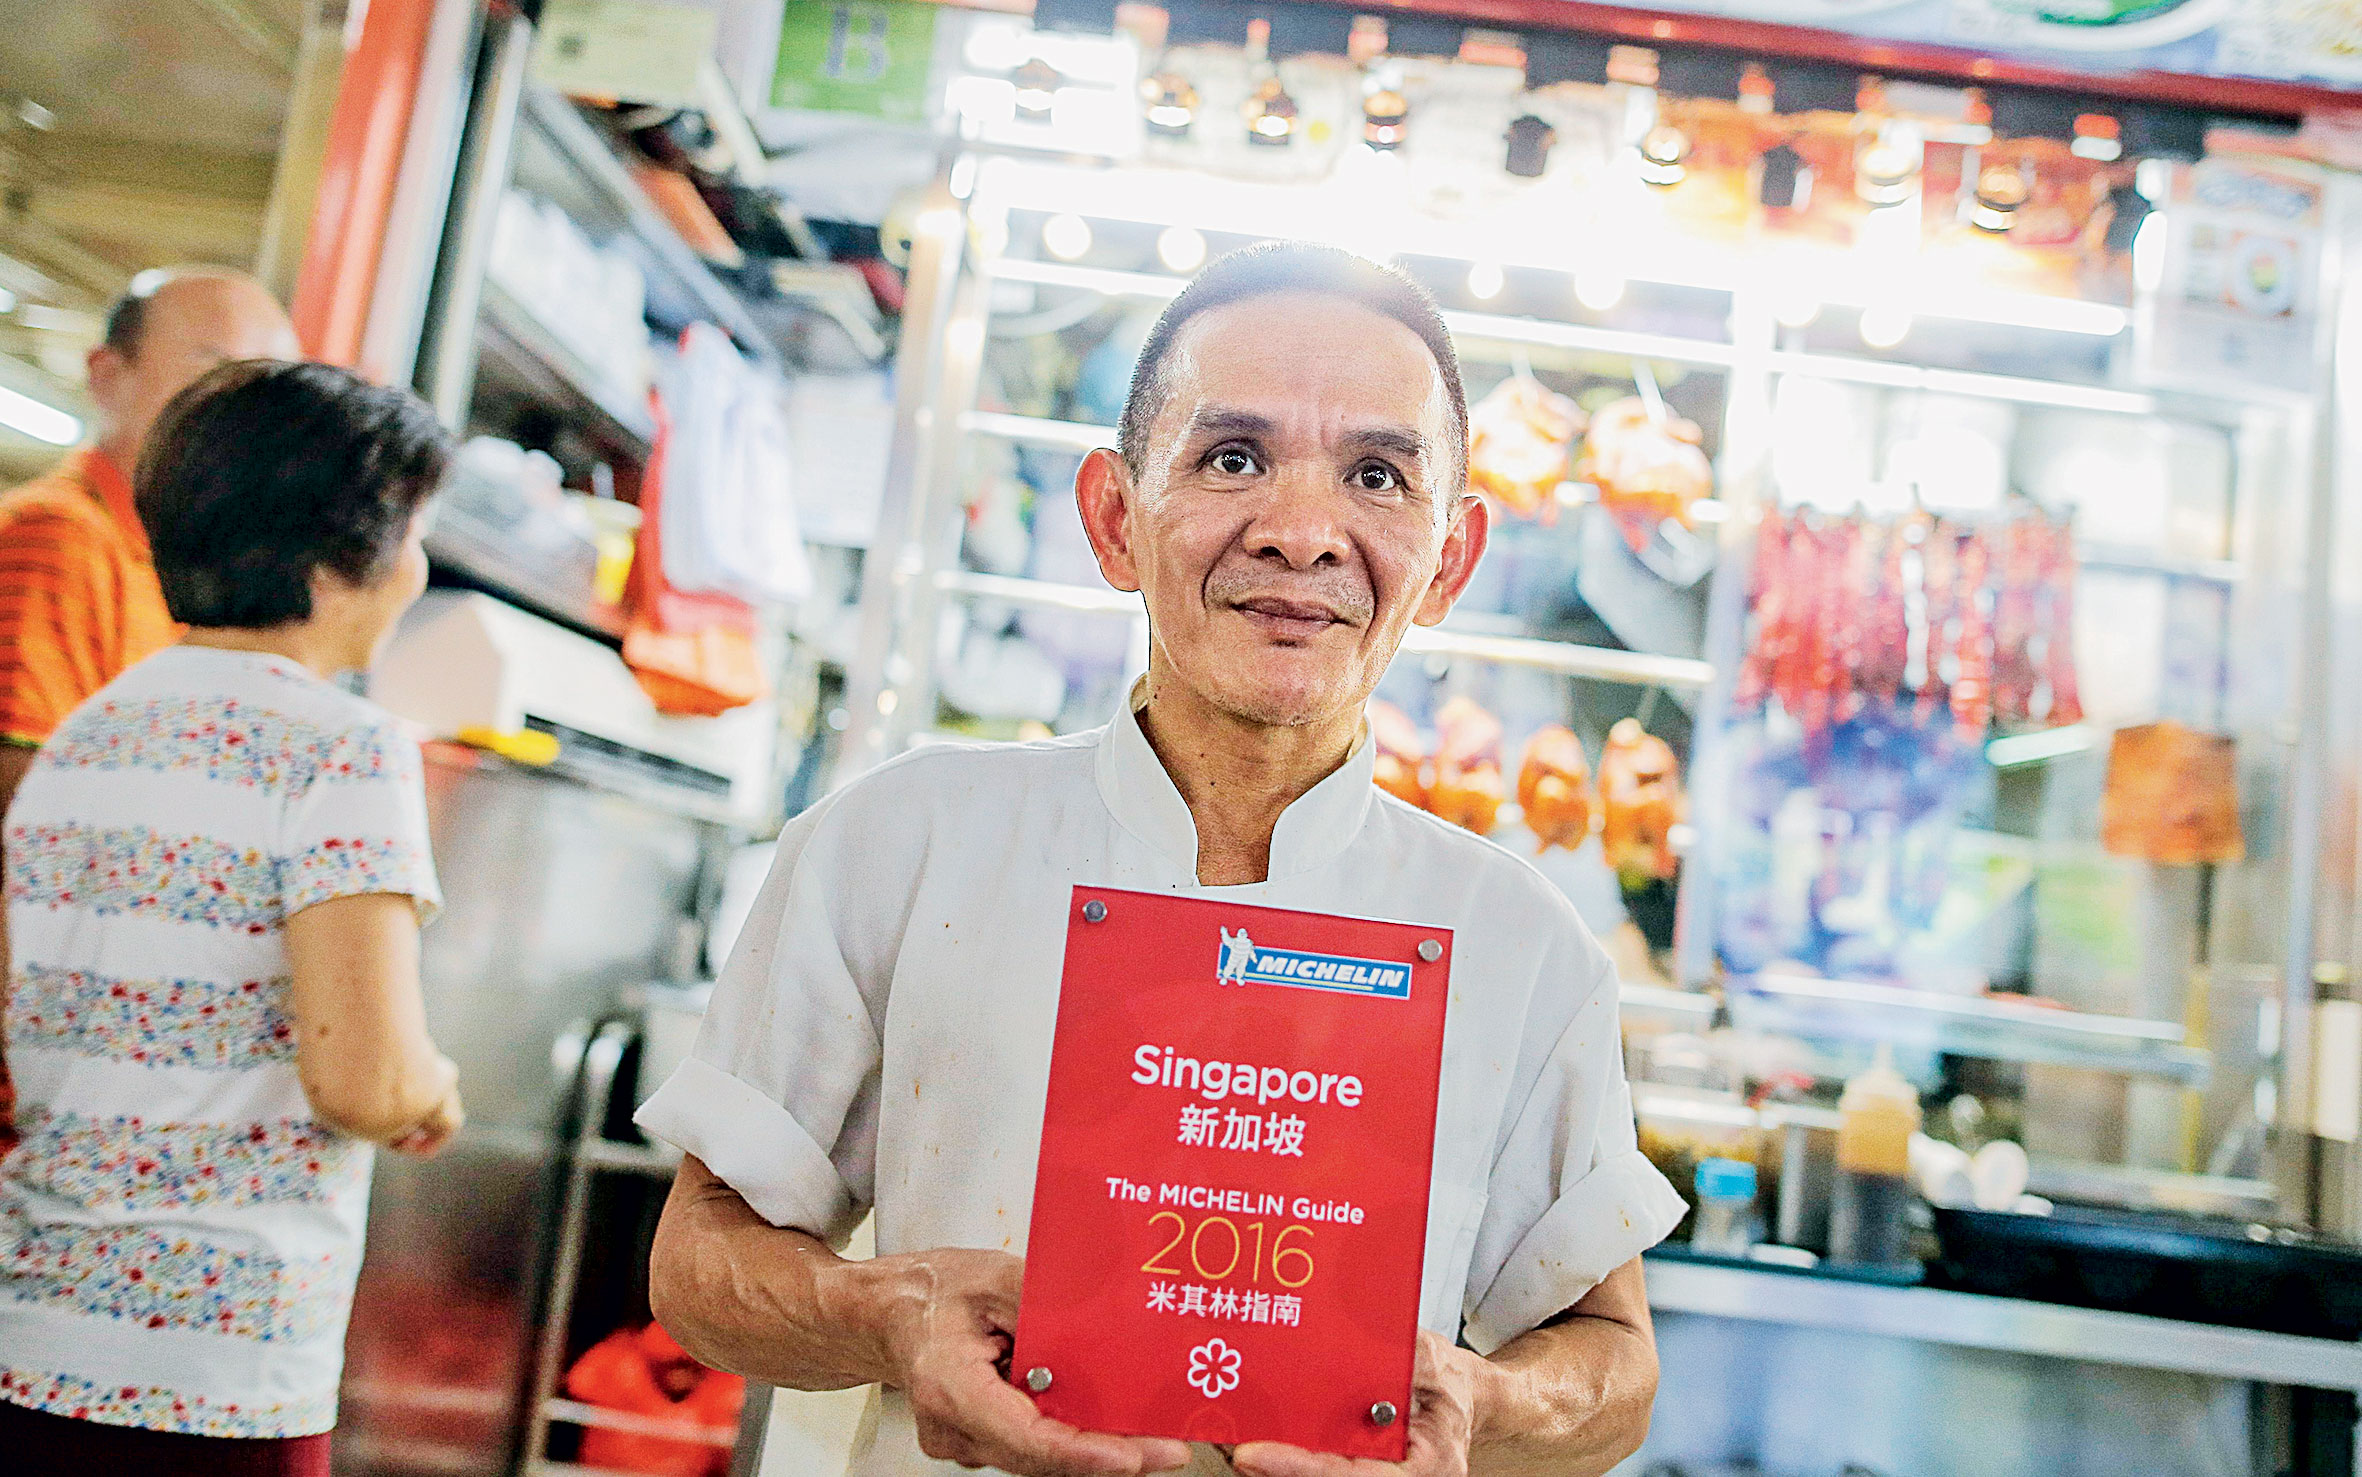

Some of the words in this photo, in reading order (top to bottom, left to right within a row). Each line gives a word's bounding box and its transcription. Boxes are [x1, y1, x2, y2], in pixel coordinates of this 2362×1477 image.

[1256, 954, 1404, 987] MICHELIN
[1131, 1044, 1363, 1107] Singapore
[1177, 1103, 1306, 1157] 新加坡
[1105, 1177, 1151, 1204] The
[1160, 1183, 1284, 1217] MICHELIN
[1292, 1198, 1365, 1225] Guide
[1140, 1210, 1316, 1288] 2016
[1146, 1281, 1302, 1327] 米其林指南
